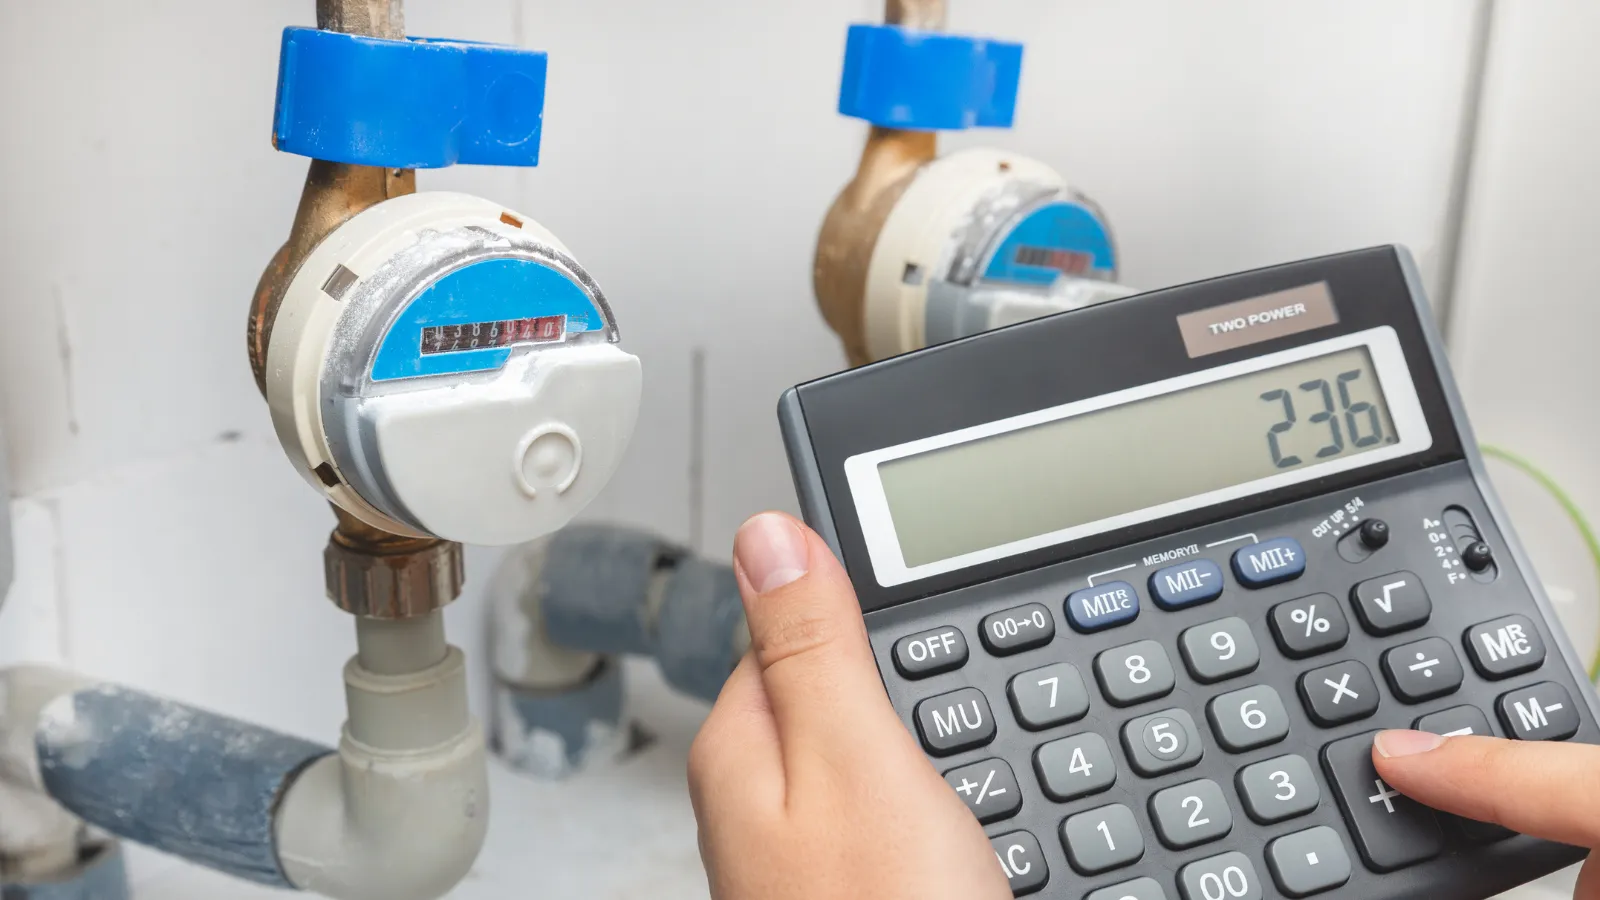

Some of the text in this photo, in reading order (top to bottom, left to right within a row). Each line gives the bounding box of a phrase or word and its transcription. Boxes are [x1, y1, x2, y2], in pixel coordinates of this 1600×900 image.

[1209, 303, 1306, 334] TWO POWER
[1311, 496, 1365, 539] CUT UP 5/4
[907, 631, 956, 662] OFF
[1210, 631, 1236, 660] 9
[1124, 654, 1151, 684] 8
[1037, 676, 1059, 708] 7
[931, 699, 982, 738] MU
[1240, 699, 1267, 729] 6
[1151, 722, 1178, 753] 5
[1068, 747, 1093, 777] 4
[1268, 770, 1296, 801] 3
[1181, 795, 1210, 828] 2
[1096, 820, 1116, 851] 1
[1199, 865, 1248, 900] 00
